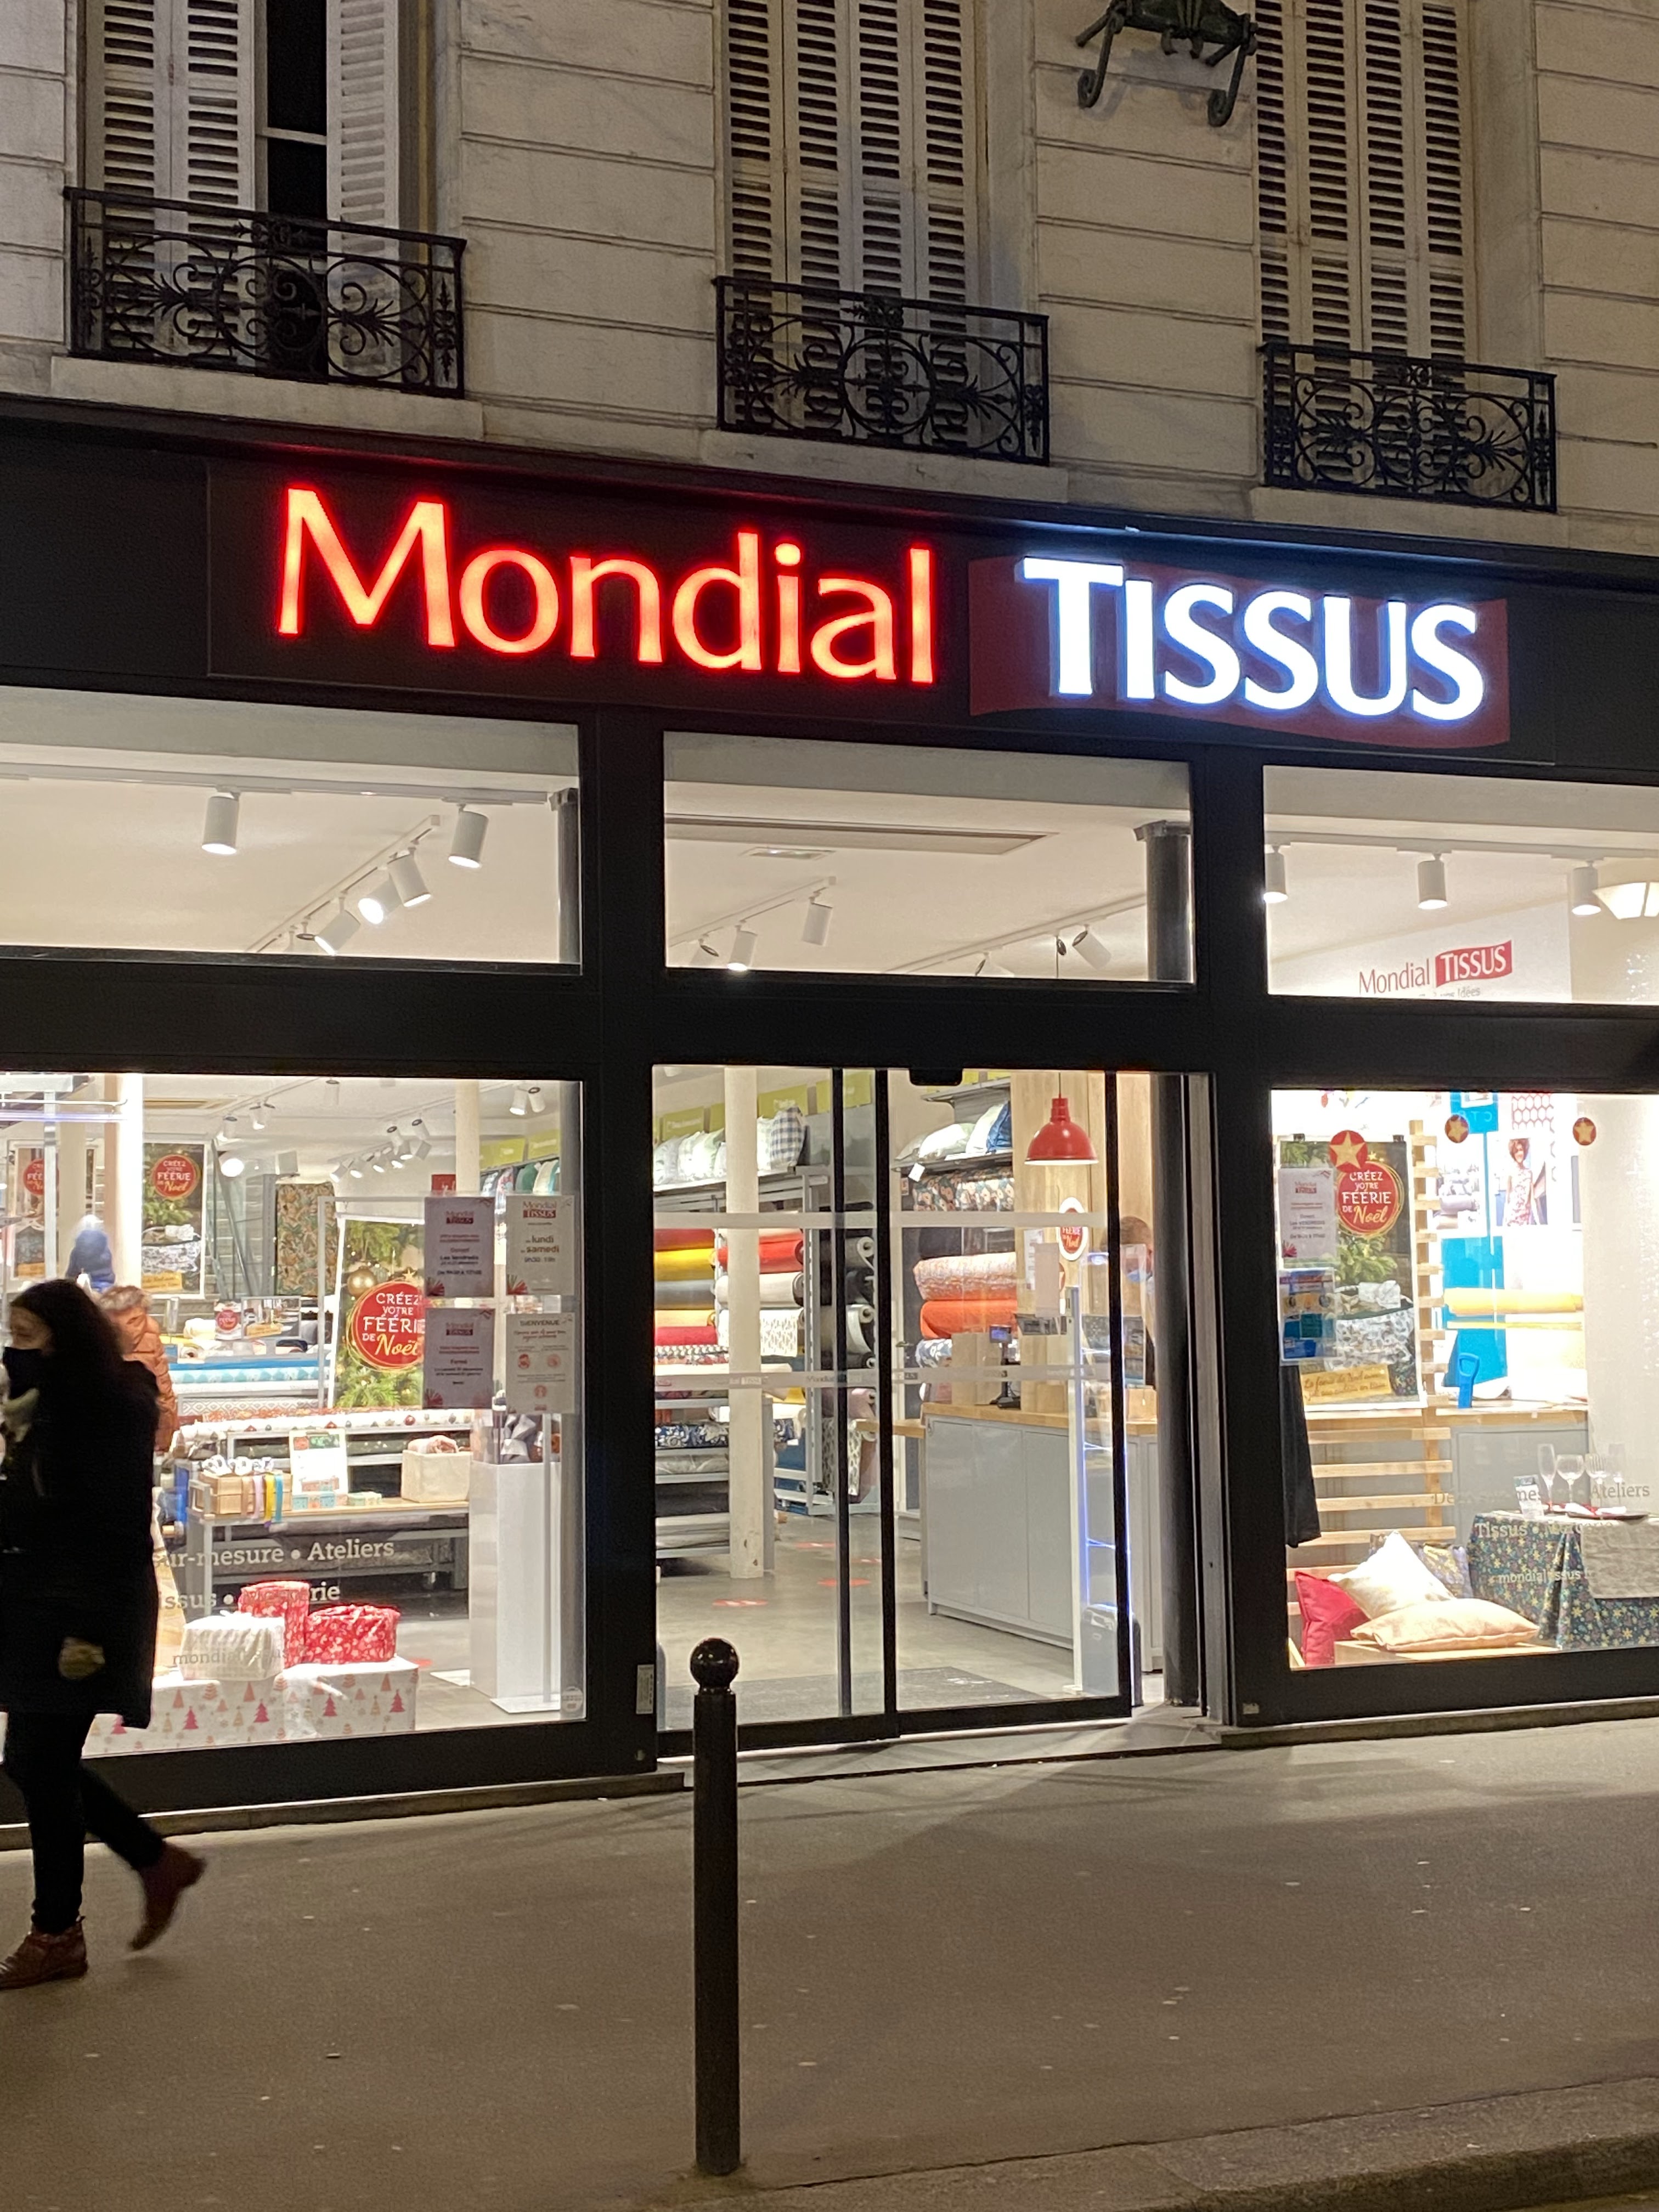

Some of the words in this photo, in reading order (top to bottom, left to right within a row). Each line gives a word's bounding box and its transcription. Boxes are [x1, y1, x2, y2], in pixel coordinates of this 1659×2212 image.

[277, 487, 934, 684] Mondial
[1019, 556, 1486, 721] TISSUS
[1359, 958, 1430, 995] Mondial
[1440, 946, 1506, 981] TISSUS
[362, 1333, 376, 1341] DE
[1475, 1522, 1527, 1538] Tissus
[308, 1538, 394, 1561] Ateliers
